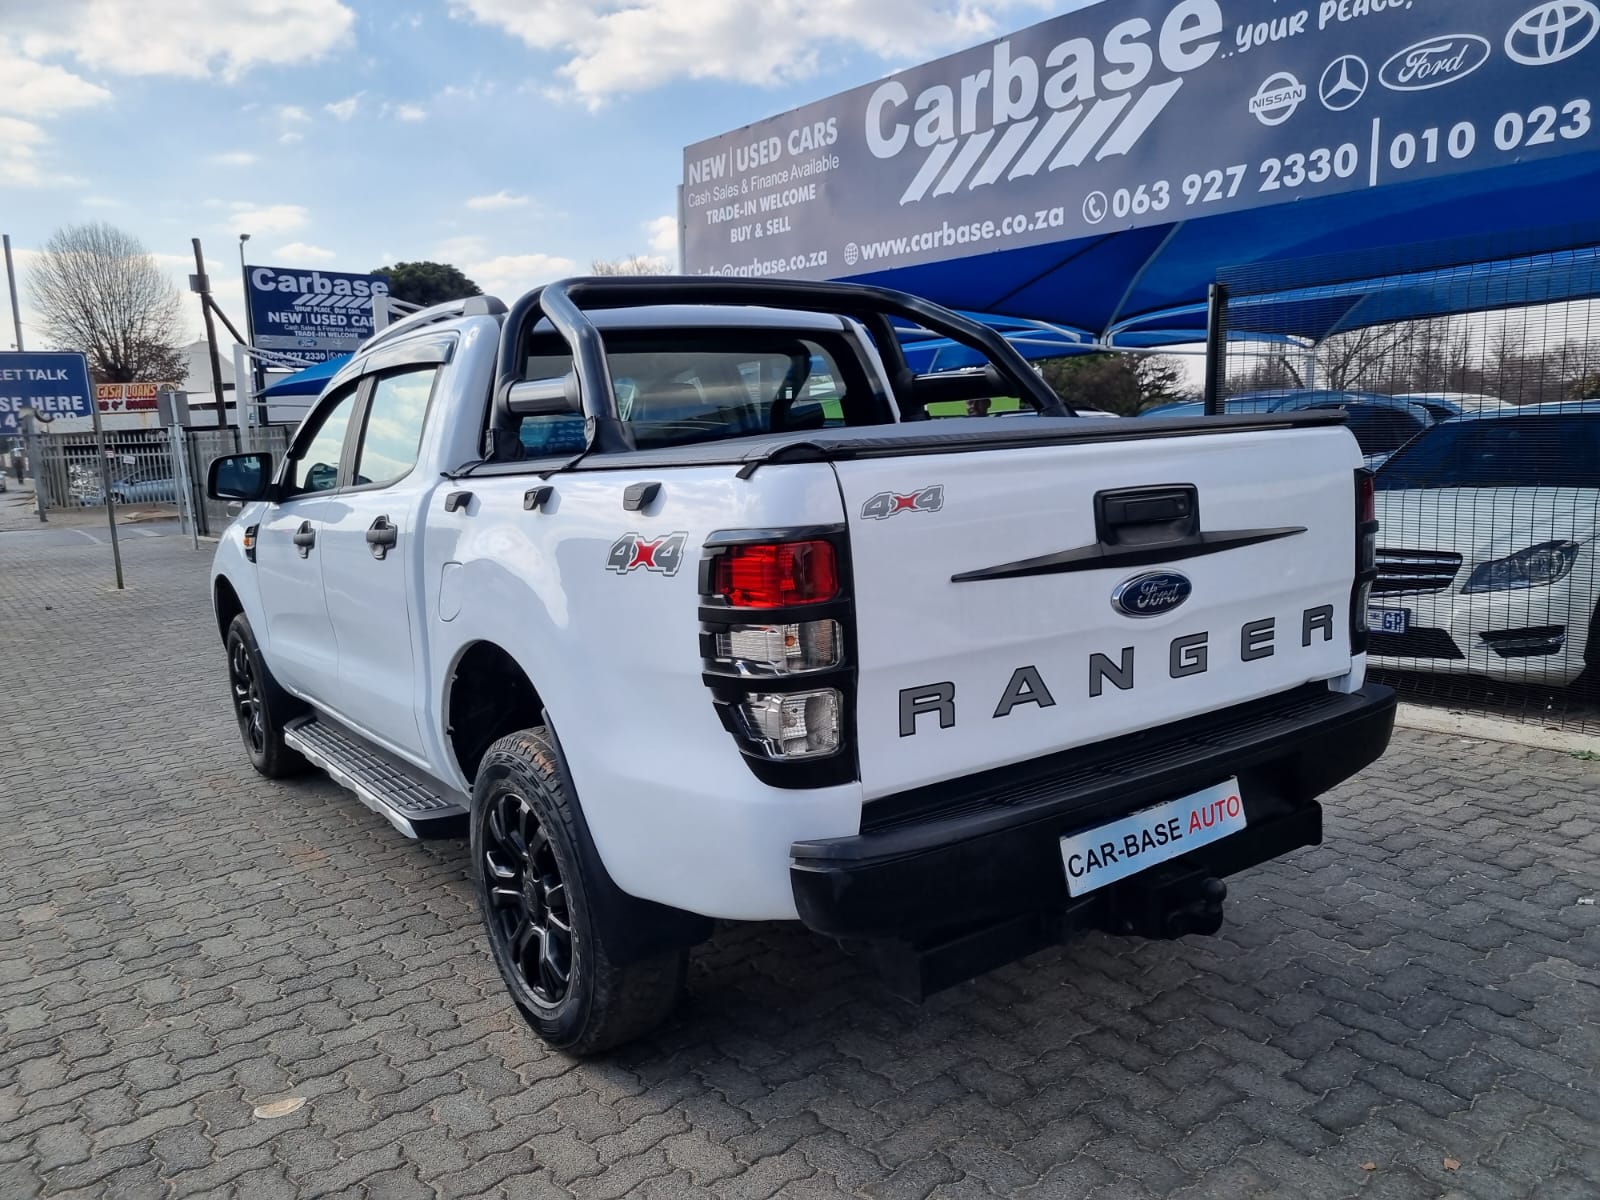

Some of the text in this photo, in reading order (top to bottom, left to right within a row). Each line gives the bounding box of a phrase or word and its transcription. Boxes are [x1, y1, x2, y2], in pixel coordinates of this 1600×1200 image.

[865, 0, 1223, 159] Carbase
[1397, 43, 1469, 84] Ford
[1251, 88, 1303, 110] NISSAN
[688, 117, 838, 186] NEW USED CARS
[1113, 99, 1591, 218] 063 927 2330 010 023
[688, 155, 840, 208] Cash Sales & Finance Available
[706, 184, 816, 225] TRADE-IN WELCOME
[730, 215, 791, 243] BUY & SELL
[861, 206, 1064, 260] www.carbase.co.za
[251, 267, 389, 297] Carbase
[268, 311, 302, 323] NEW
[310, 314, 347, 326] USED
[0, 369, 69, 380] ET TALK
[97, 383, 158, 399] CASH LOANS
[30, 396, 84, 411] HERE
[1137, 579, 1180, 608] Ford
[899, 604, 1334, 737] RANGER
[1068, 795, 1240, 877] CAR-BASE AUTO
